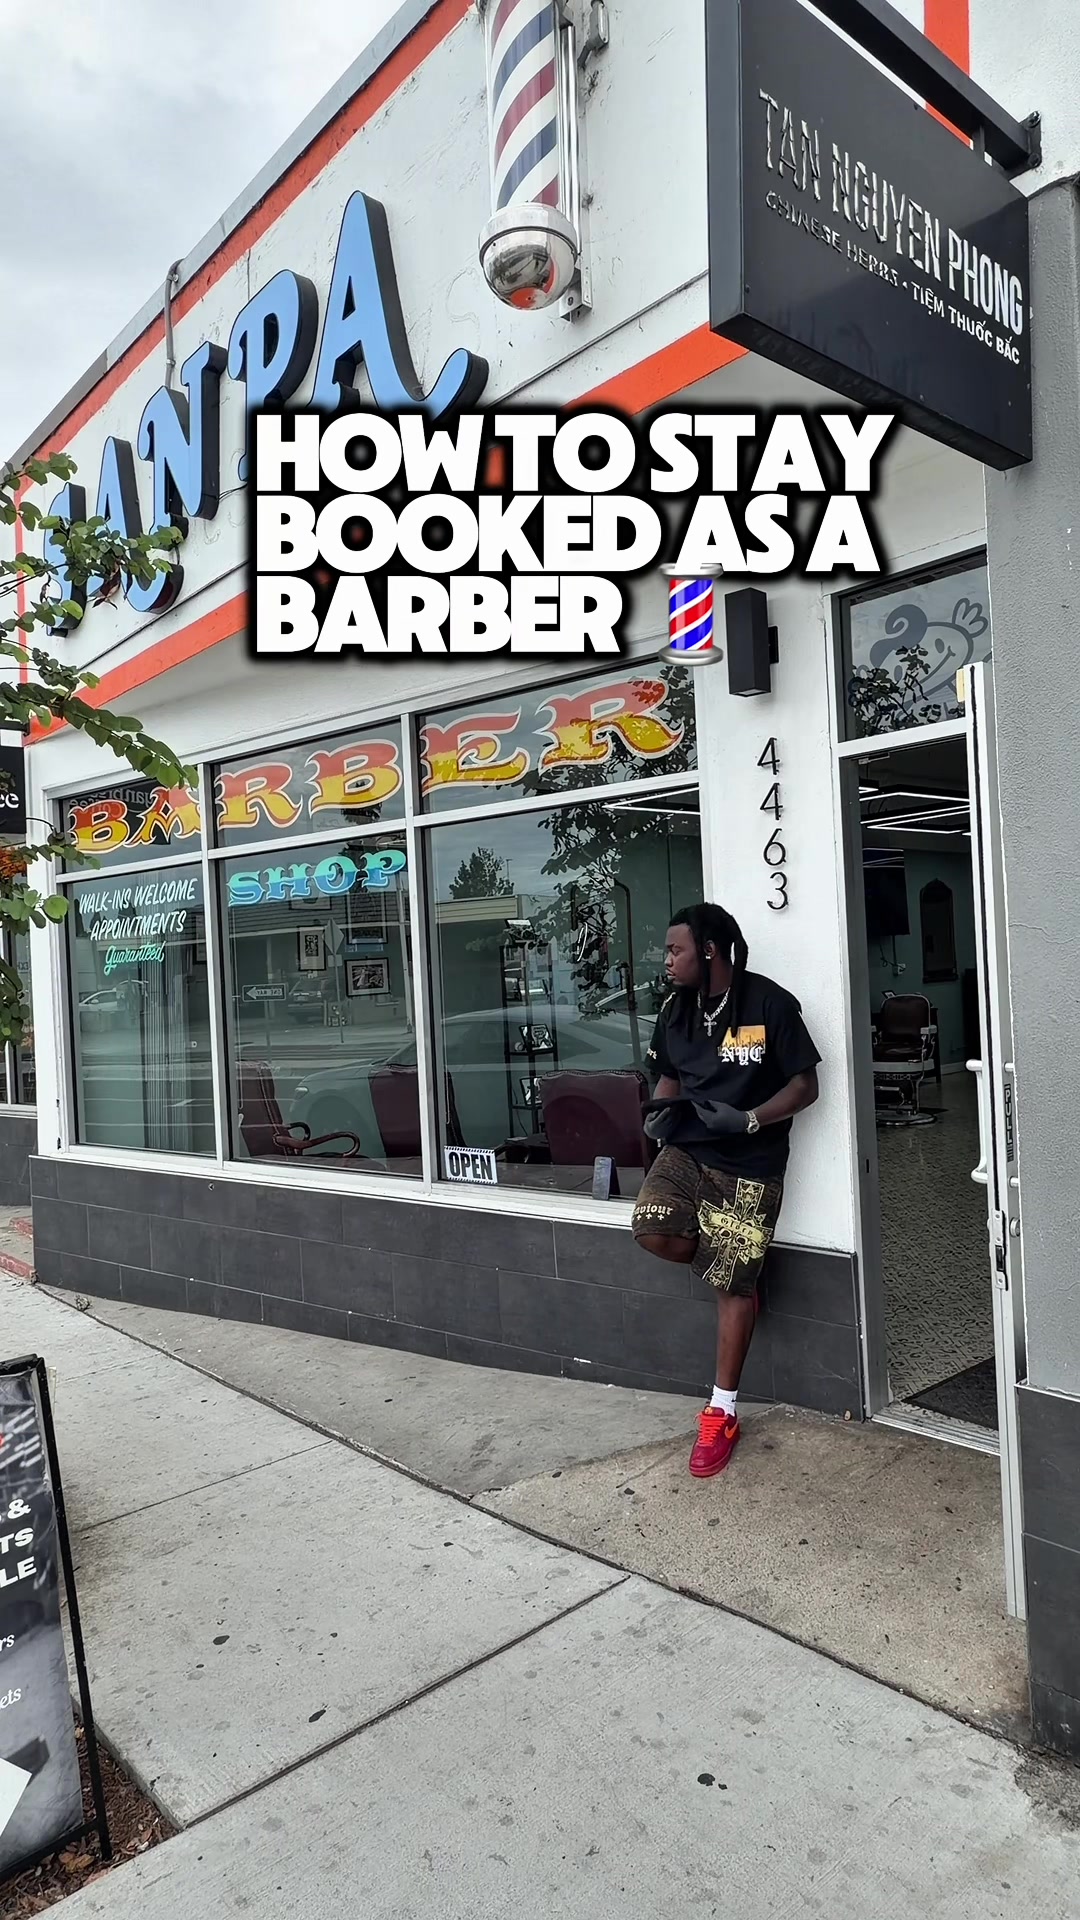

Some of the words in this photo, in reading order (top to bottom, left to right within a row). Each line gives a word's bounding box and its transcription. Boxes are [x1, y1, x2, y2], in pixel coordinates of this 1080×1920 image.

[759, 88, 821, 201] TAN
[832, 142, 941, 282] NGUYEN
[948, 228, 1023, 336] PHONG
[766, 190, 842, 253] CHINESE
[847, 240, 898, 287] HERBS
[911, 281, 945, 317] TIỆM
[948, 305, 993, 348] THUỐC
[996, 335, 1020, 365] BẮC
[67, 676, 685, 854] BARBER
[757, 737, 789, 911] 4463
[79, 888, 132, 914] WALK-INS
[134, 878, 198, 907] WELCOME
[227, 849, 407, 907] SHOP
[90, 910, 187, 941] APPOINTMENTS
[1004, 1089, 1013, 1144] PULL
[448, 1152, 493, 1181] OPEN
